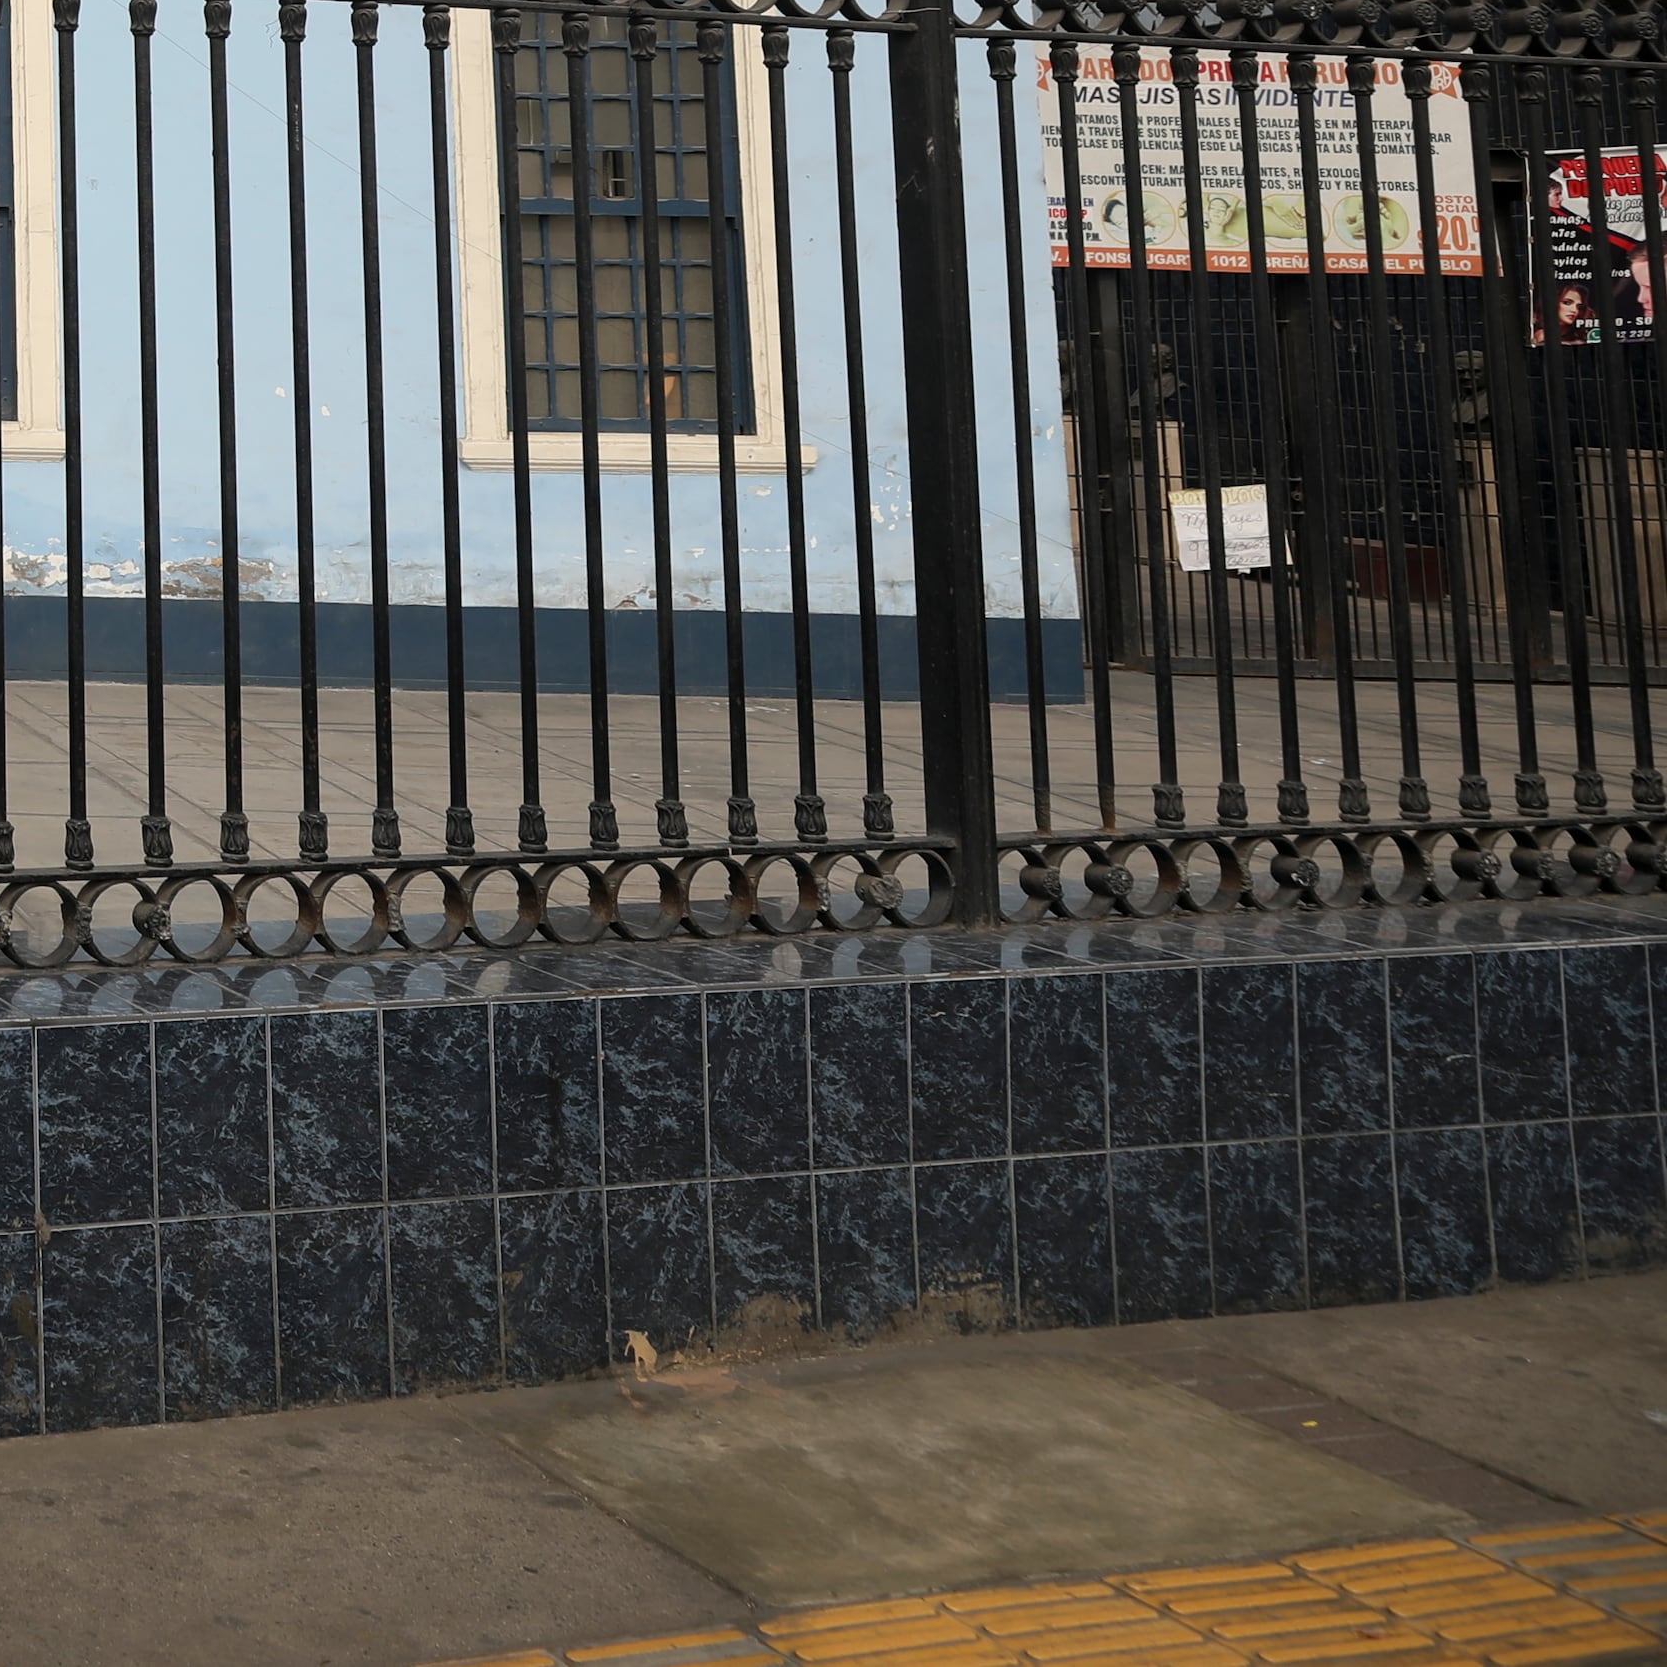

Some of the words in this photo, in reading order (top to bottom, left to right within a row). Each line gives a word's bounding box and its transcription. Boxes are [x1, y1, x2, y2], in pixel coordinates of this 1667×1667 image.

[1075, 114, 1119, 125] NTAMOS
[1325, 119, 1339, 130] EN
[1088, 124, 1122, 137] TRAVÉ
[1147, 128, 1167, 138] SUS
[1225, 129, 1239, 140] DE
[1258, 130, 1291, 141] SAJES
[1339, 131, 1346, 141] A
[1405, 132, 1411, 142] Y
[1076, 138, 1108, 149] CLASE
[1200, 141, 1227, 152] ESDE
[1258, 142, 1293, 154] ÍSICAS
[1333, 144, 1353, 155] LAS
[1169, 165, 1218, 176] MAJES
[1335, 180, 1341, 191] Y
[1083, 197, 1094, 207] EN
[1435, 195, 1474, 204] OSTO
[1435, 204, 1478, 214] OCIAL
[1549, 216, 1584, 225] amas,
[1210, 255, 1248, 268] 1012
[1327, 257, 1368, 269] CASA
[1409, 259, 1472, 271] PUBLO
